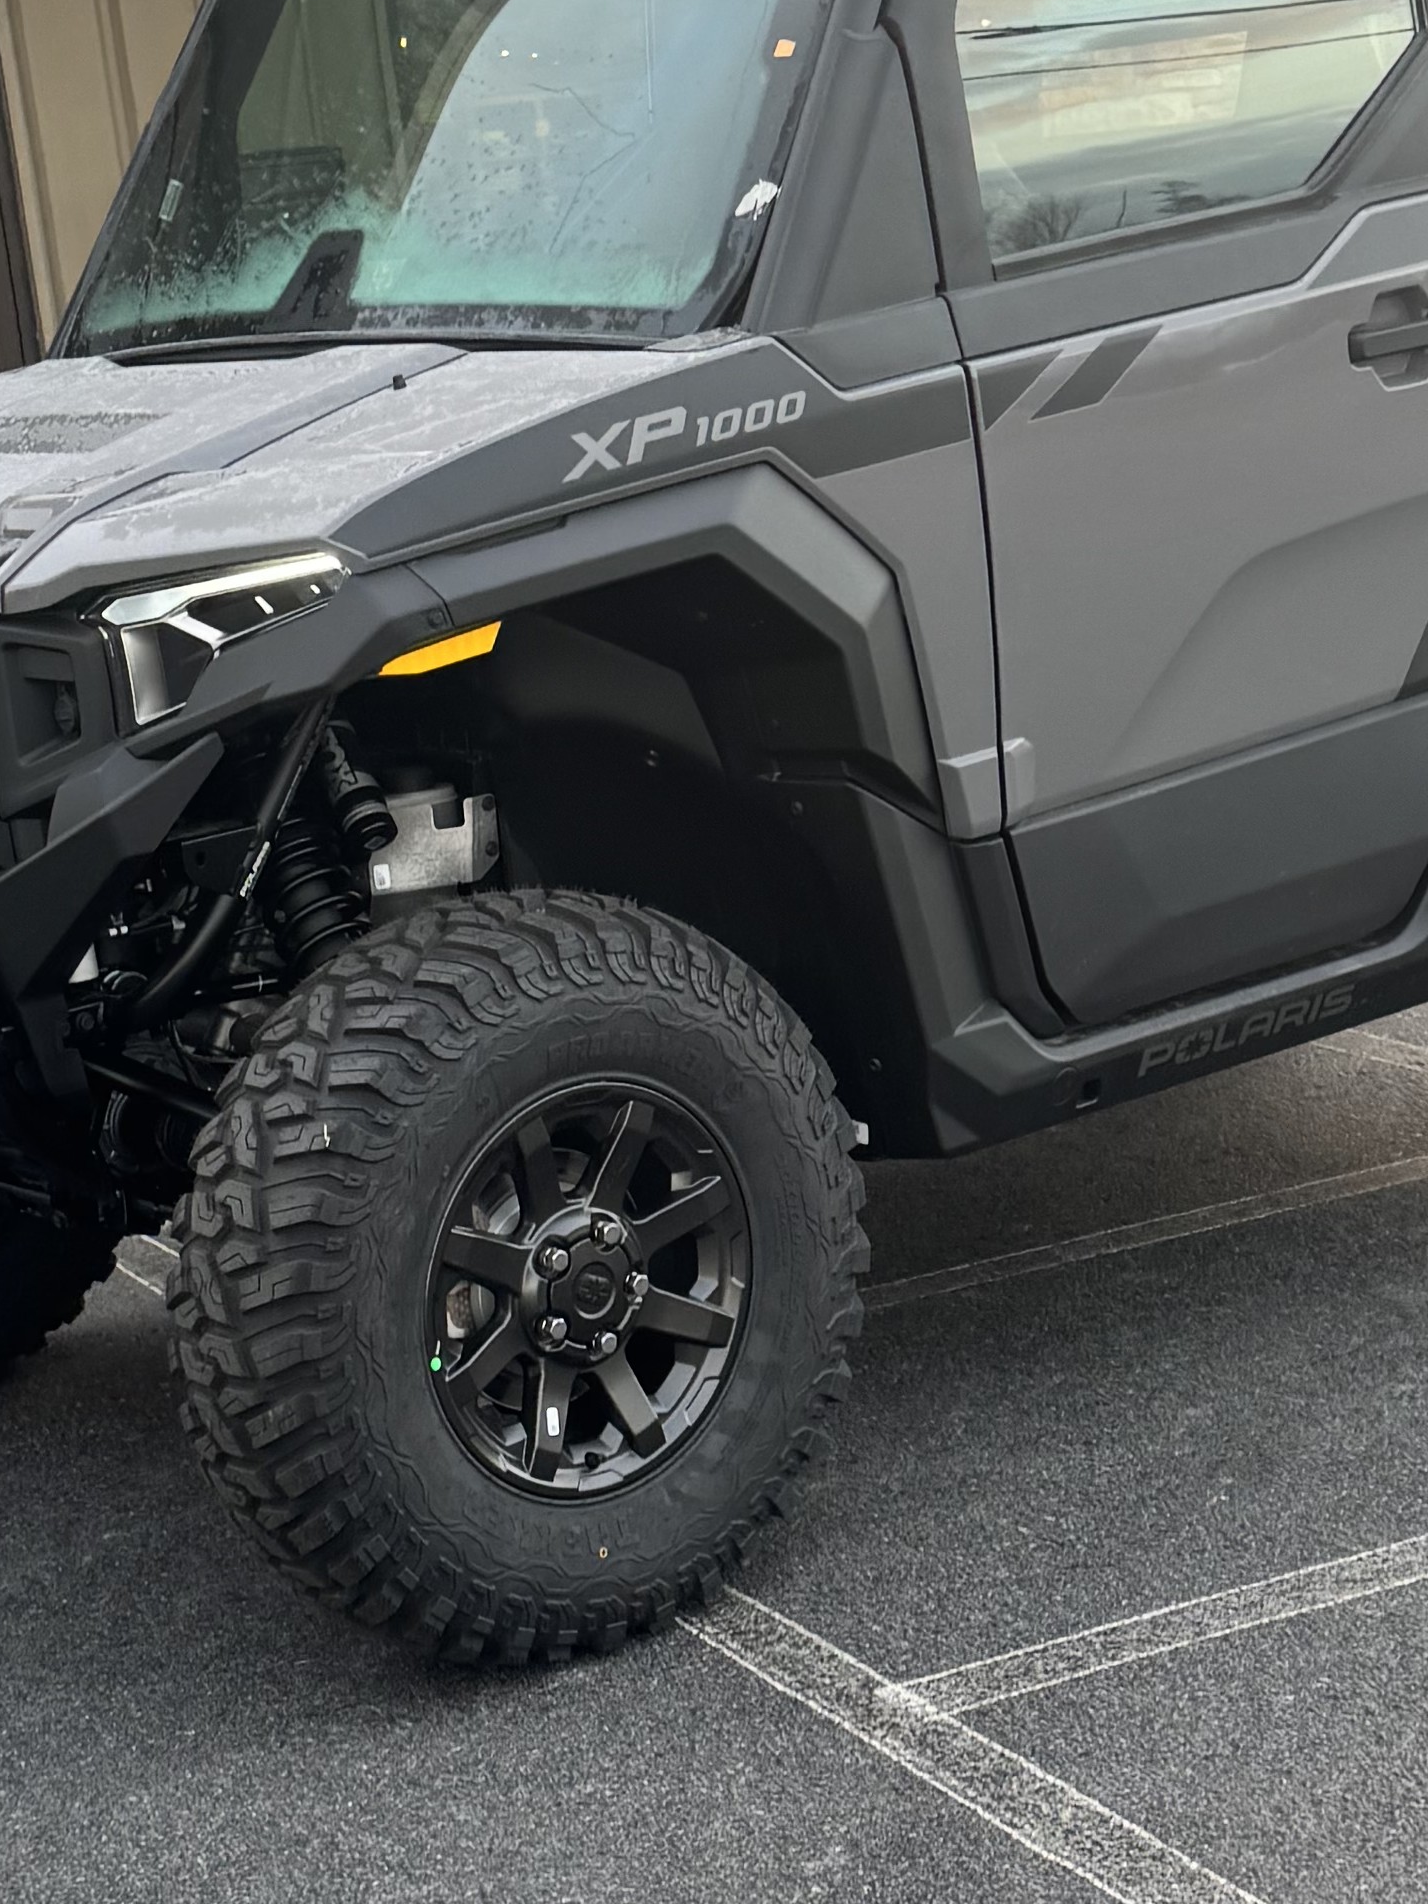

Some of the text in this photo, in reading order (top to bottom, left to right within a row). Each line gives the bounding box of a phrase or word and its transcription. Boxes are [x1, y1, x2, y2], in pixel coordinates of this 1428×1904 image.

[562, 390, 807, 483] XP 1000
[1137, 983, 1356, 1078] POLARIS
